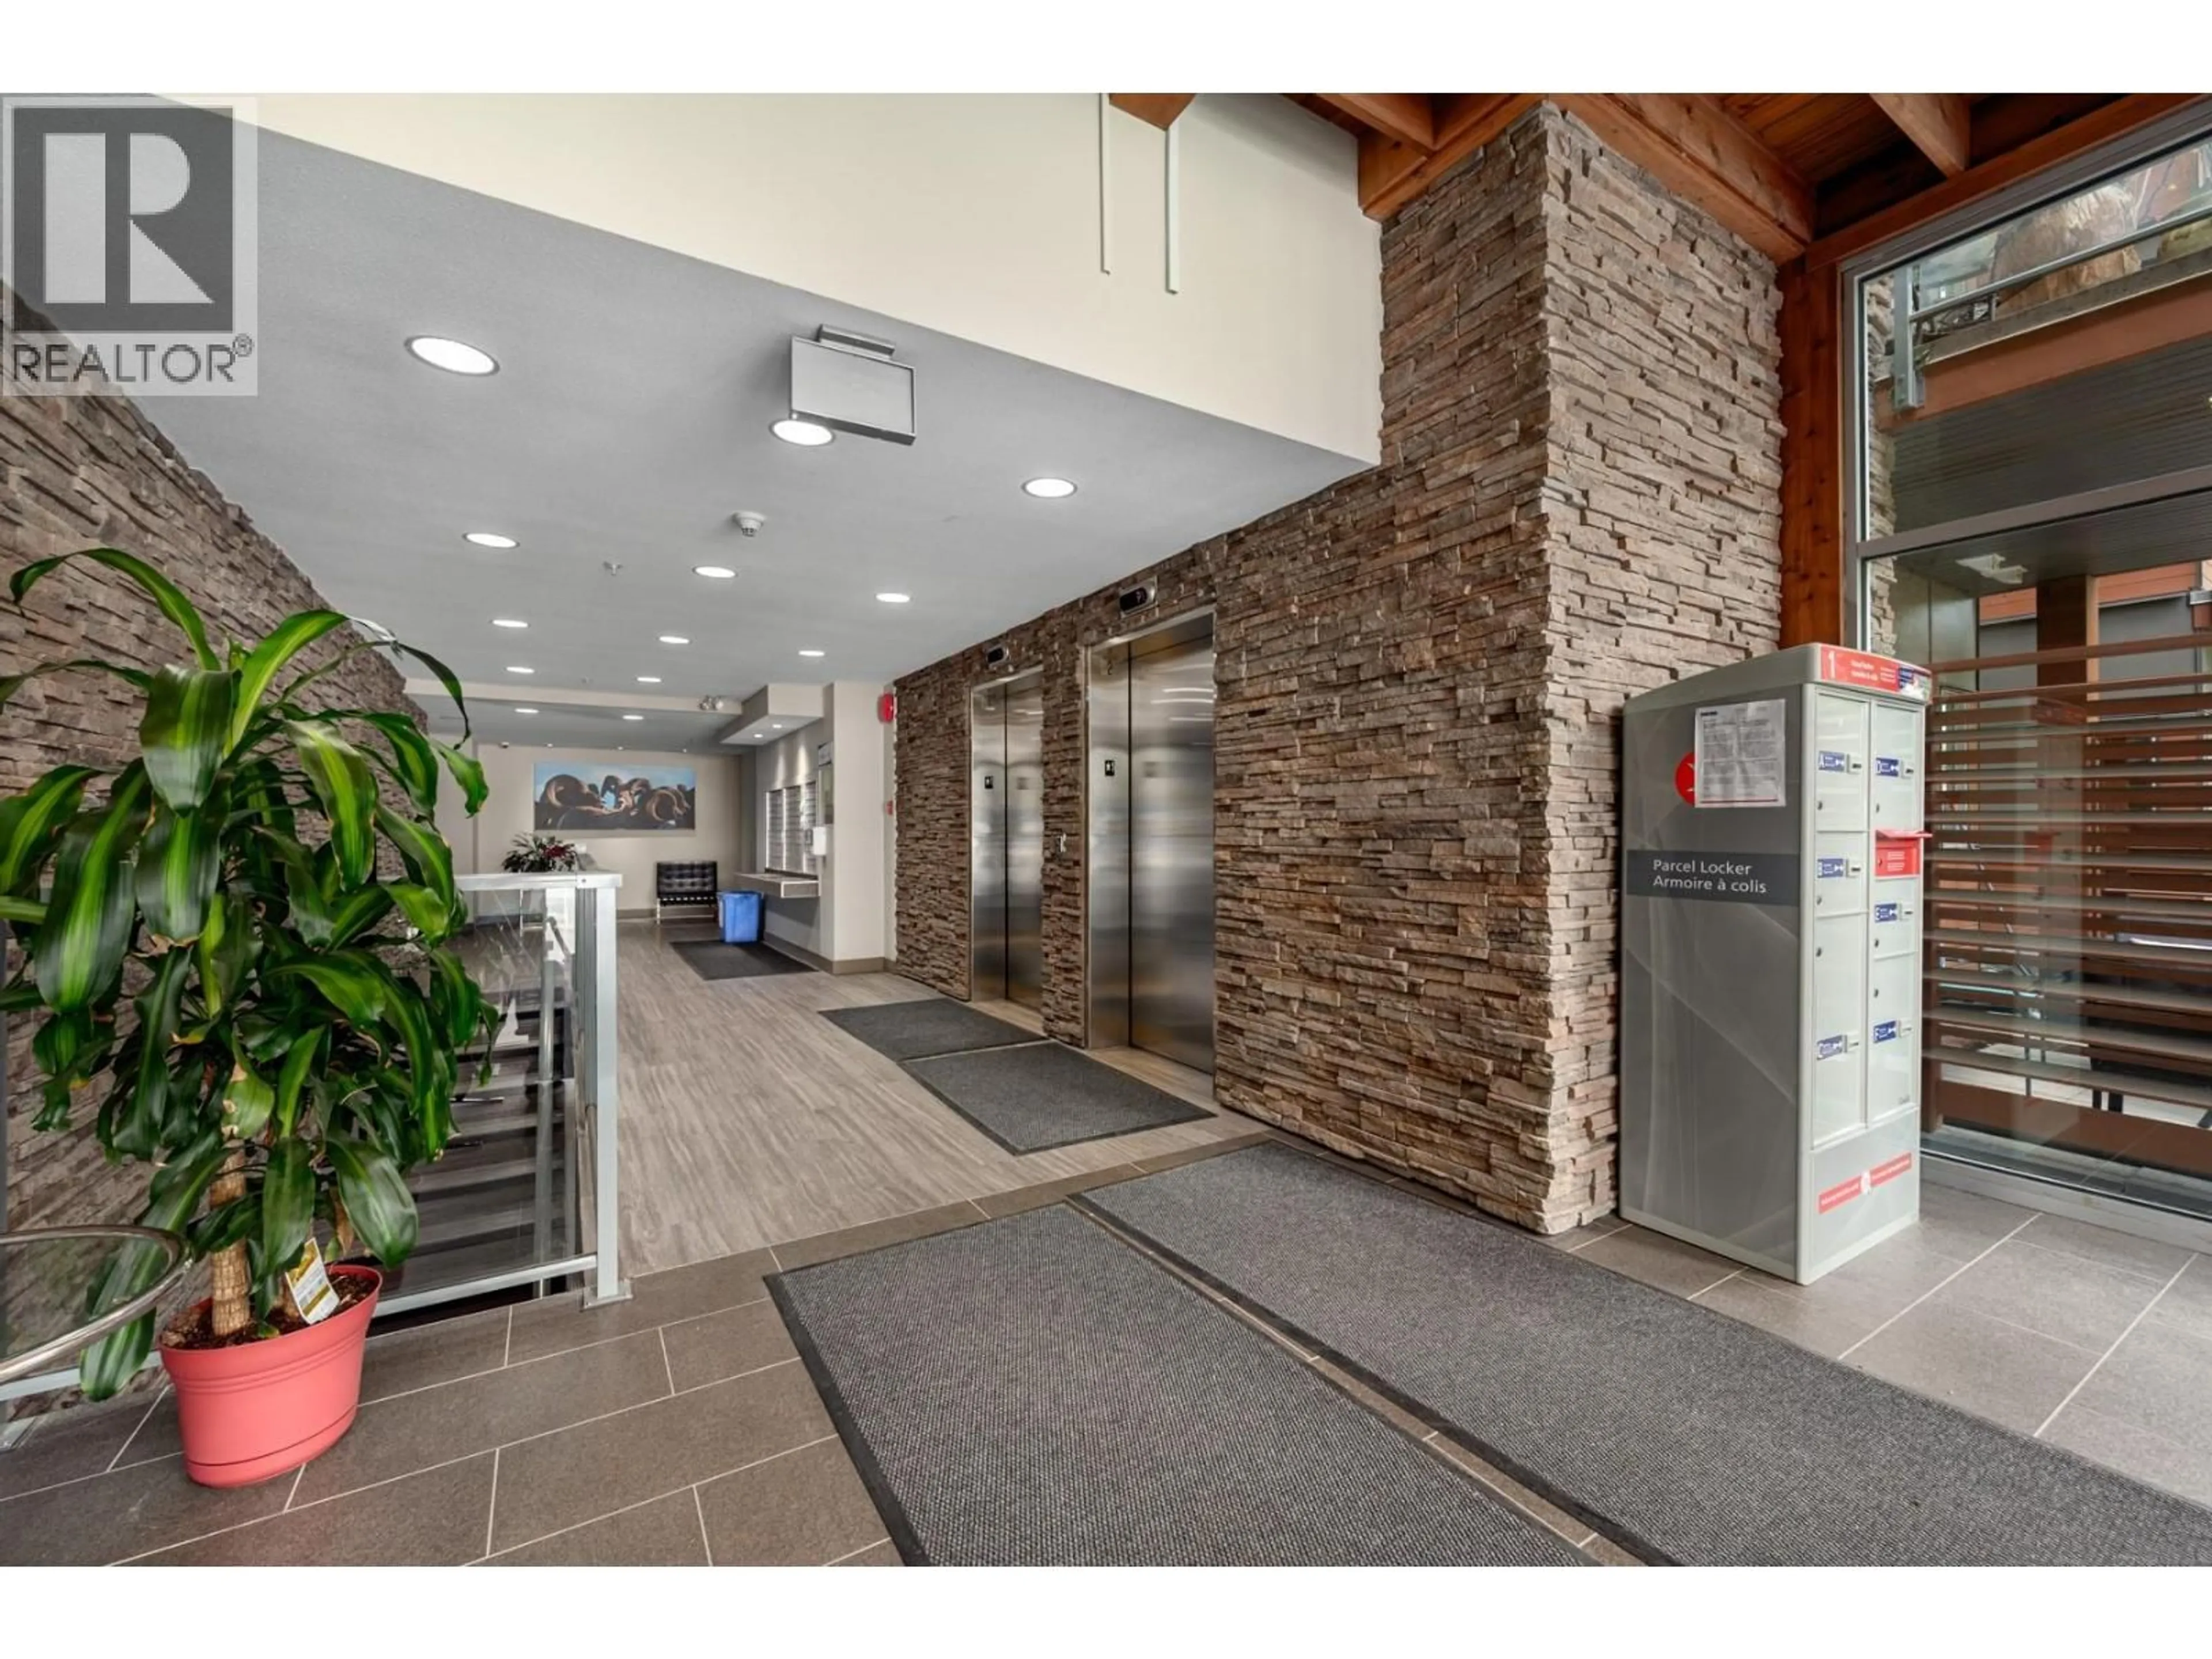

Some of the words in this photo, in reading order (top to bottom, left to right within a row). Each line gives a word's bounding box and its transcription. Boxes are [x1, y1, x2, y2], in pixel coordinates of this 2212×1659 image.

[1653, 859, 1696, 873] Parcel
[1700, 860, 1753, 875] Locker
[1653, 874, 1713, 890] Armoire
[1717, 877, 1726, 891] à
[1730, 878, 1767, 893] colis
